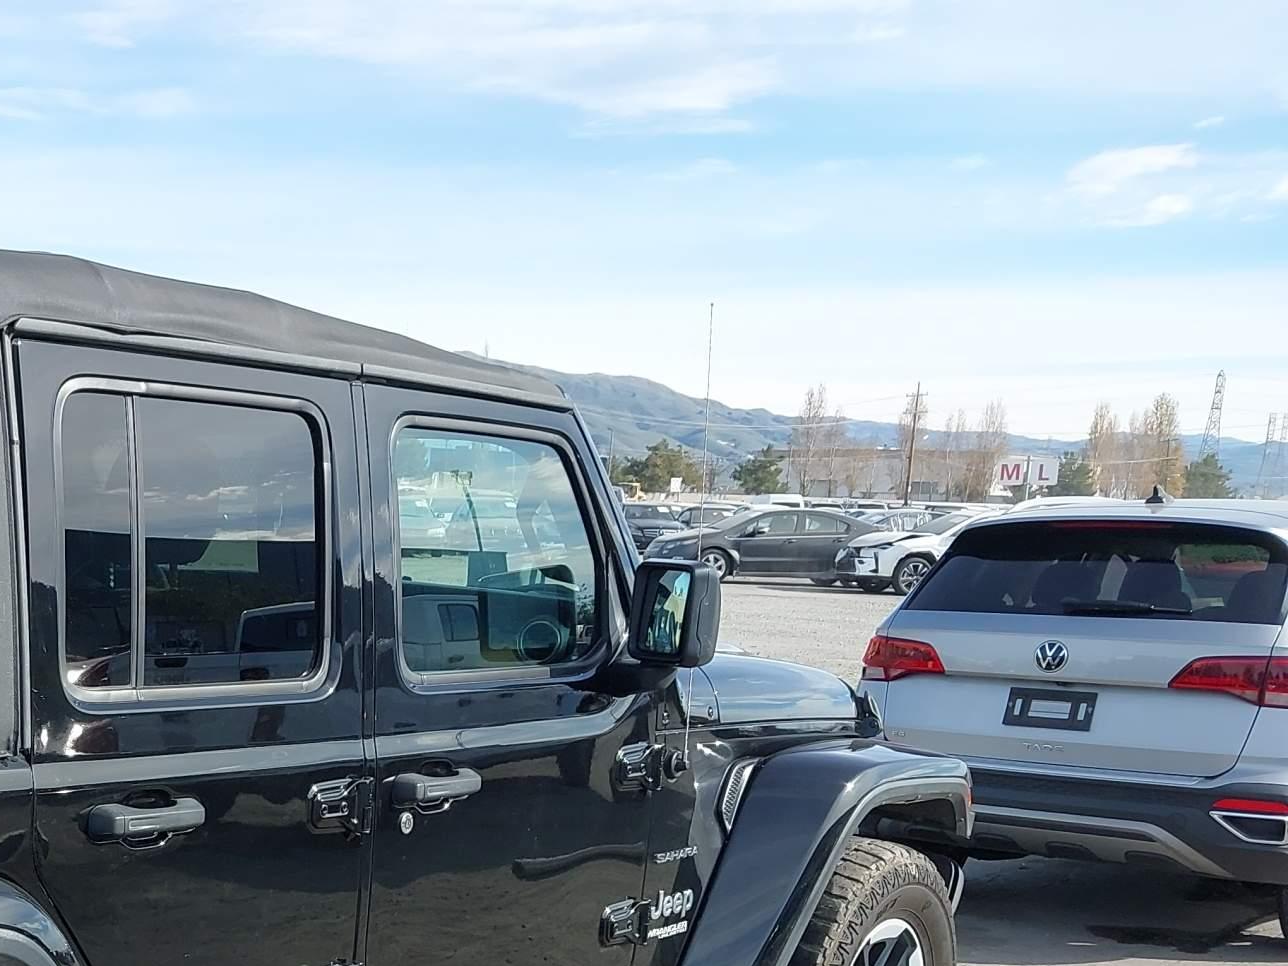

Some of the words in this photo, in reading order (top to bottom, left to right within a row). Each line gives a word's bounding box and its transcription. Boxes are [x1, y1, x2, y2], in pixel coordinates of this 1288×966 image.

[1000, 463, 1021, 481] M
[1037, 463, 1049, 481] L
[653, 846, 698, 864] SAHARA
[650, 889, 694, 920] Jeep
[647, 920, 688, 938] WRANGLER
